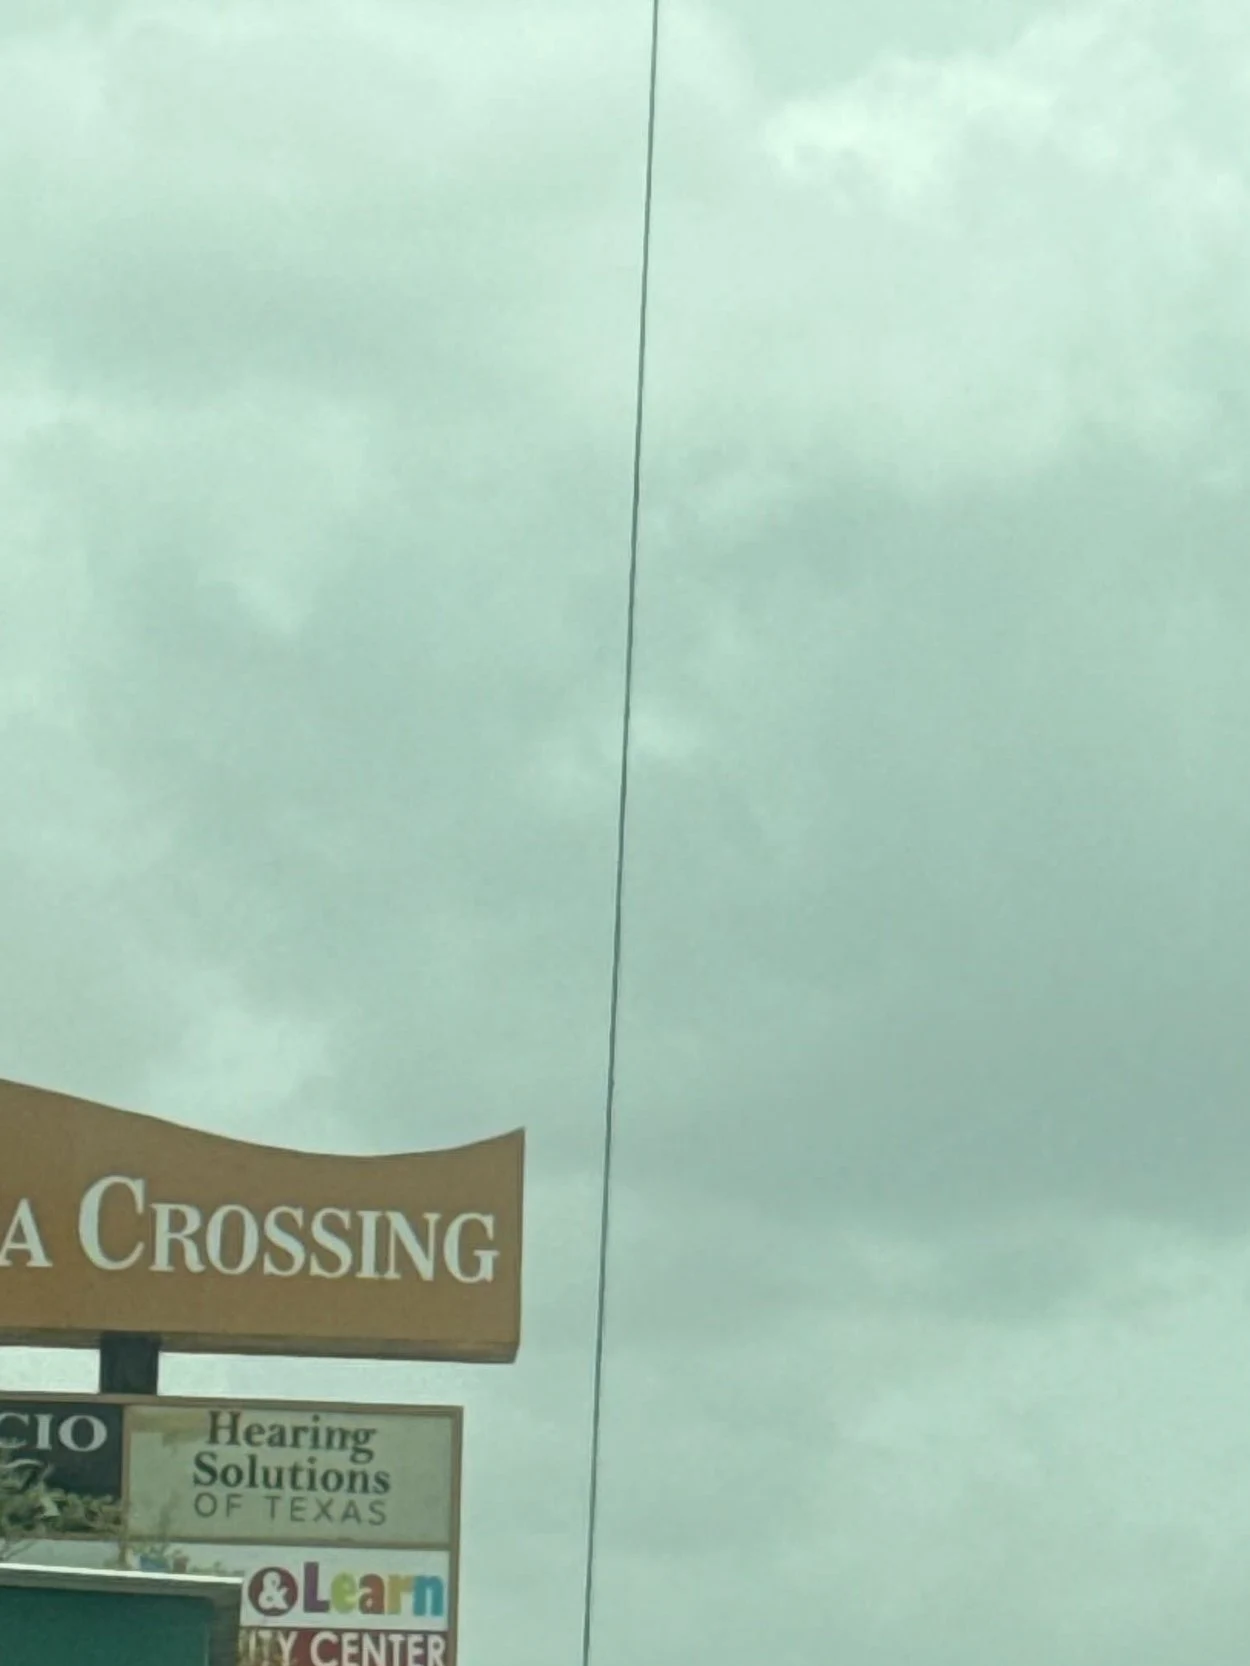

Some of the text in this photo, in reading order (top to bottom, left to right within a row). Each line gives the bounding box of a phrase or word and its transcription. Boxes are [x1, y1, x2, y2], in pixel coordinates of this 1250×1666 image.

[207, 1410, 376, 1464] Hearing
[192, 1451, 391, 1496] Solutions
[193, 1492, 388, 1527] OF TEXAS
[303, 1561, 444, 1617] Learn
